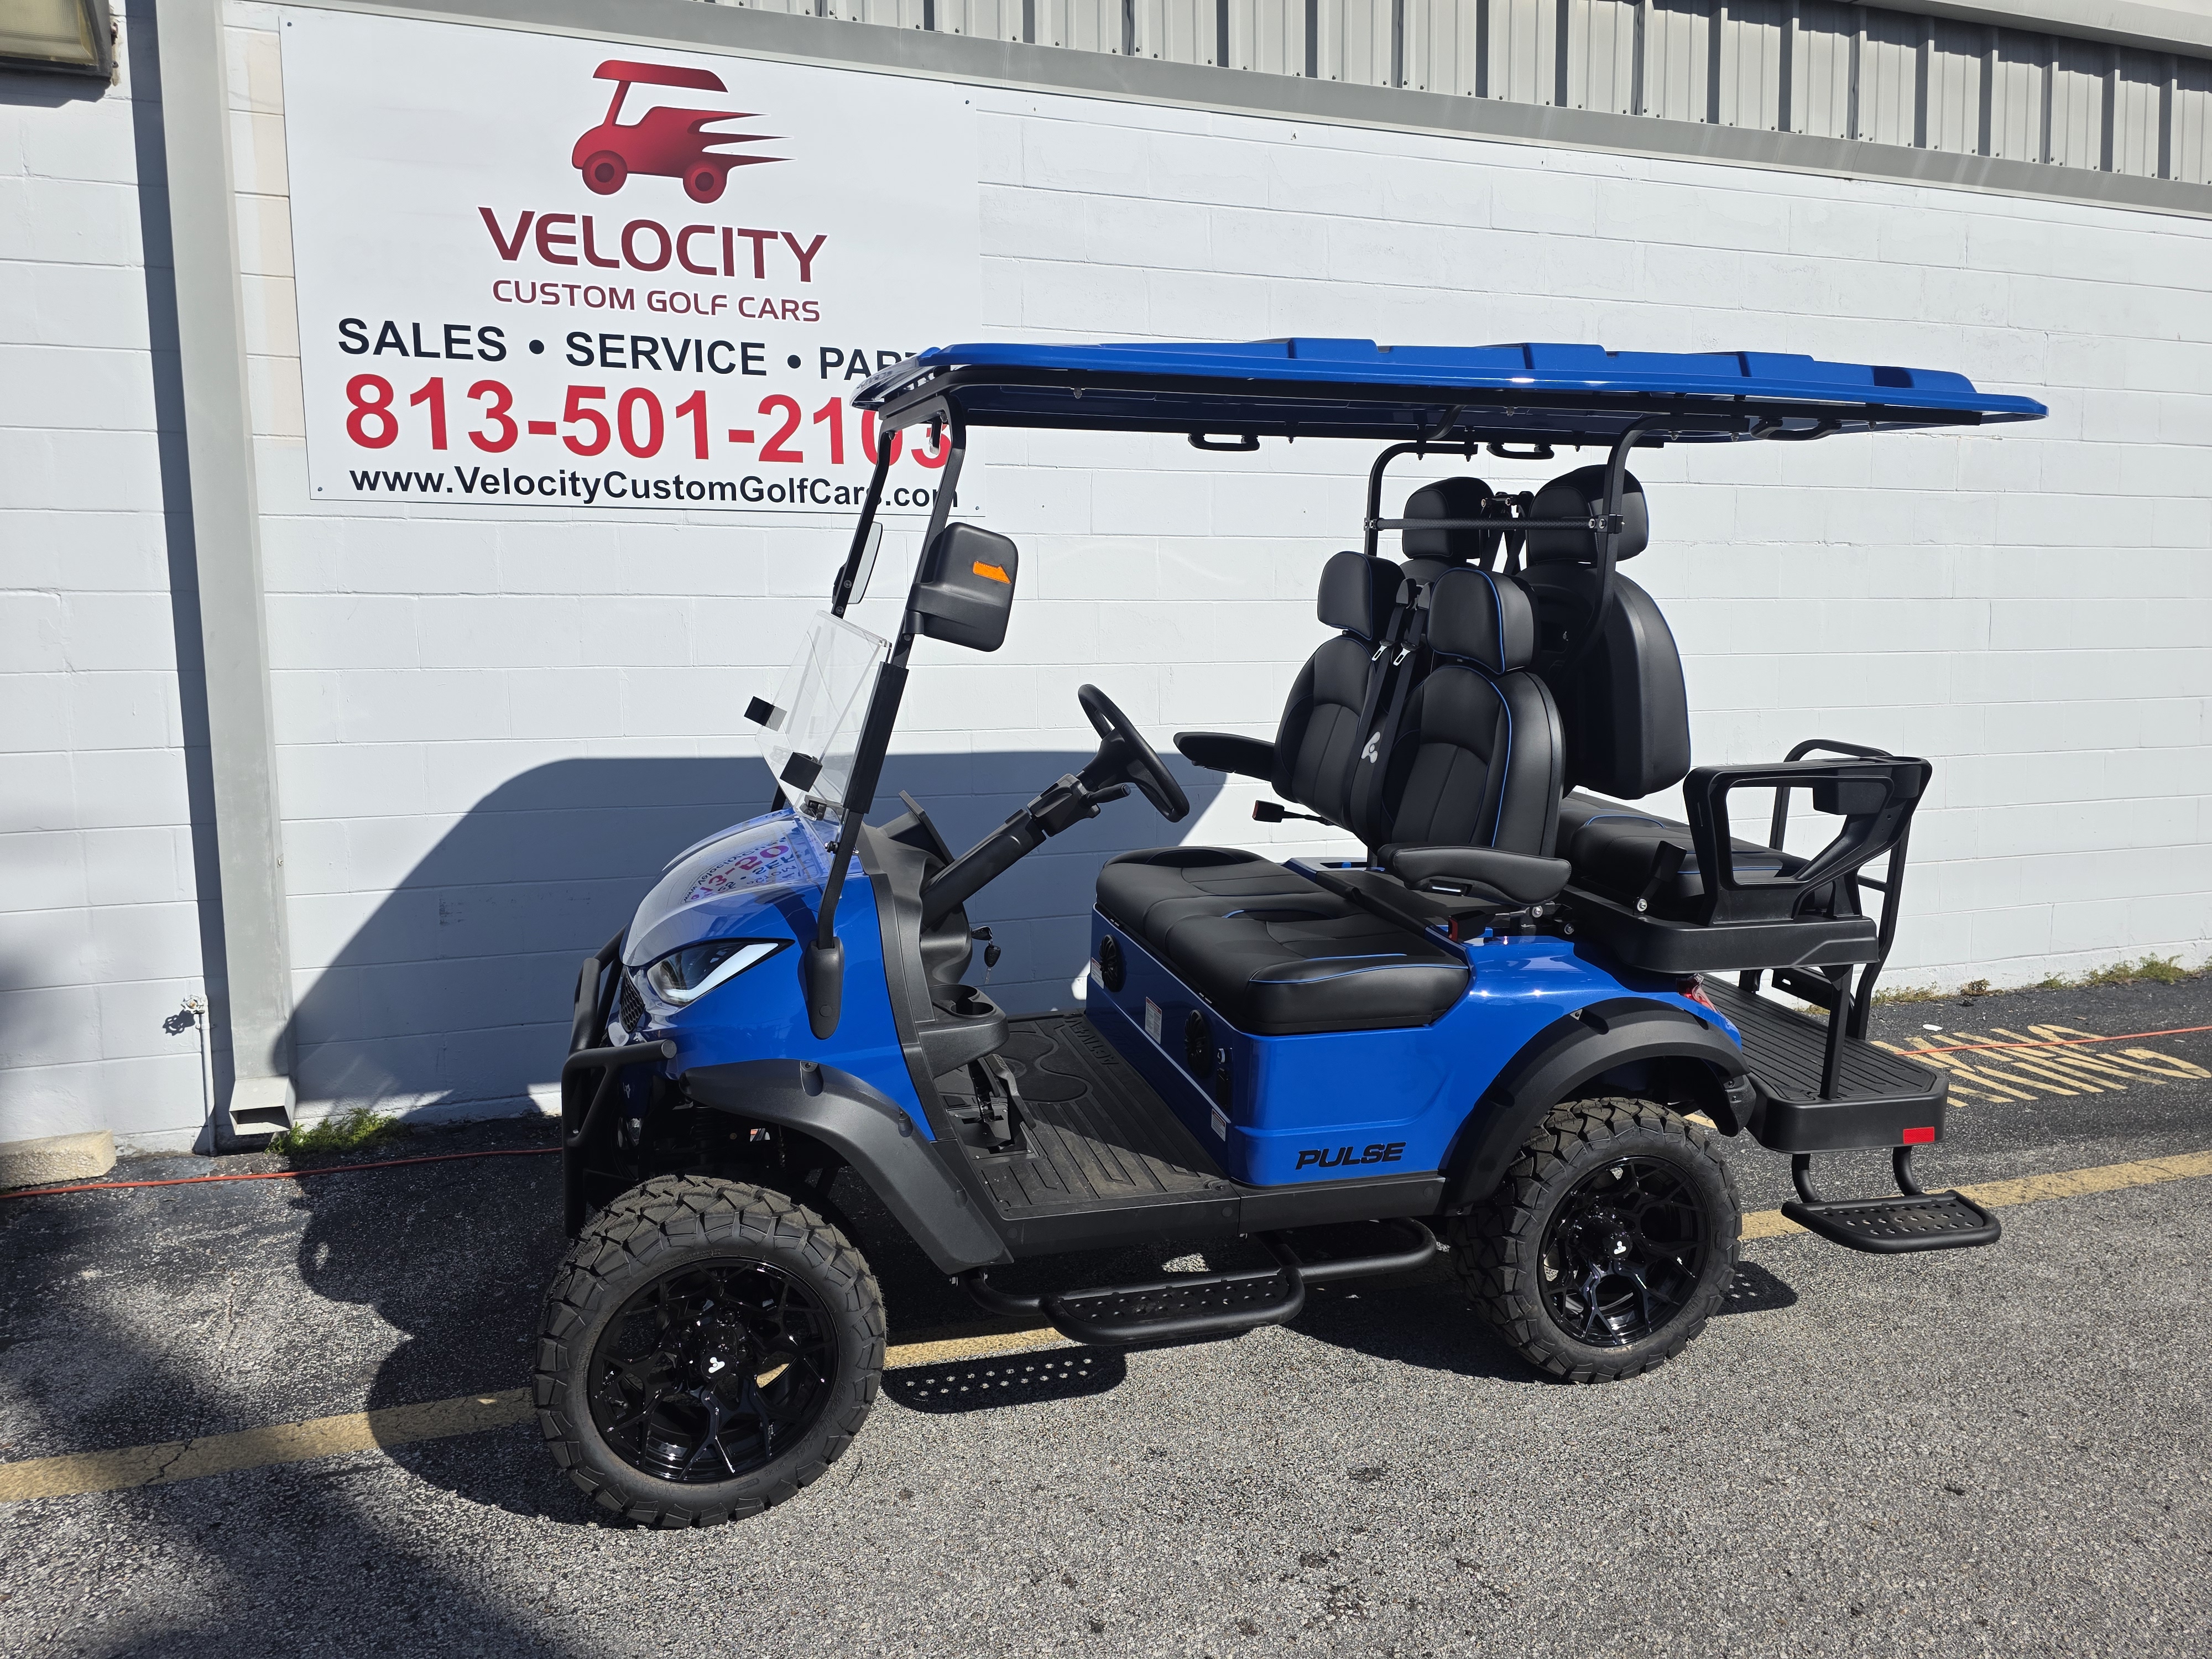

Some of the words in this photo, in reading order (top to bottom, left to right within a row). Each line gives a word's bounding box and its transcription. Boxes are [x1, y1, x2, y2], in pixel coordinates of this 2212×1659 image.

[480, 208, 825, 281] VELOCITY
[493, 280, 635, 310] CUSTOM
[647, 290, 727, 315] GOLF
[739, 296, 821, 322] CARS
[339, 318, 507, 361] SALES
[566, 332, 767, 375] SERVICE
[820, 347, 918, 380] PAR
[1295, 1141, 1406, 1170] PULSE
